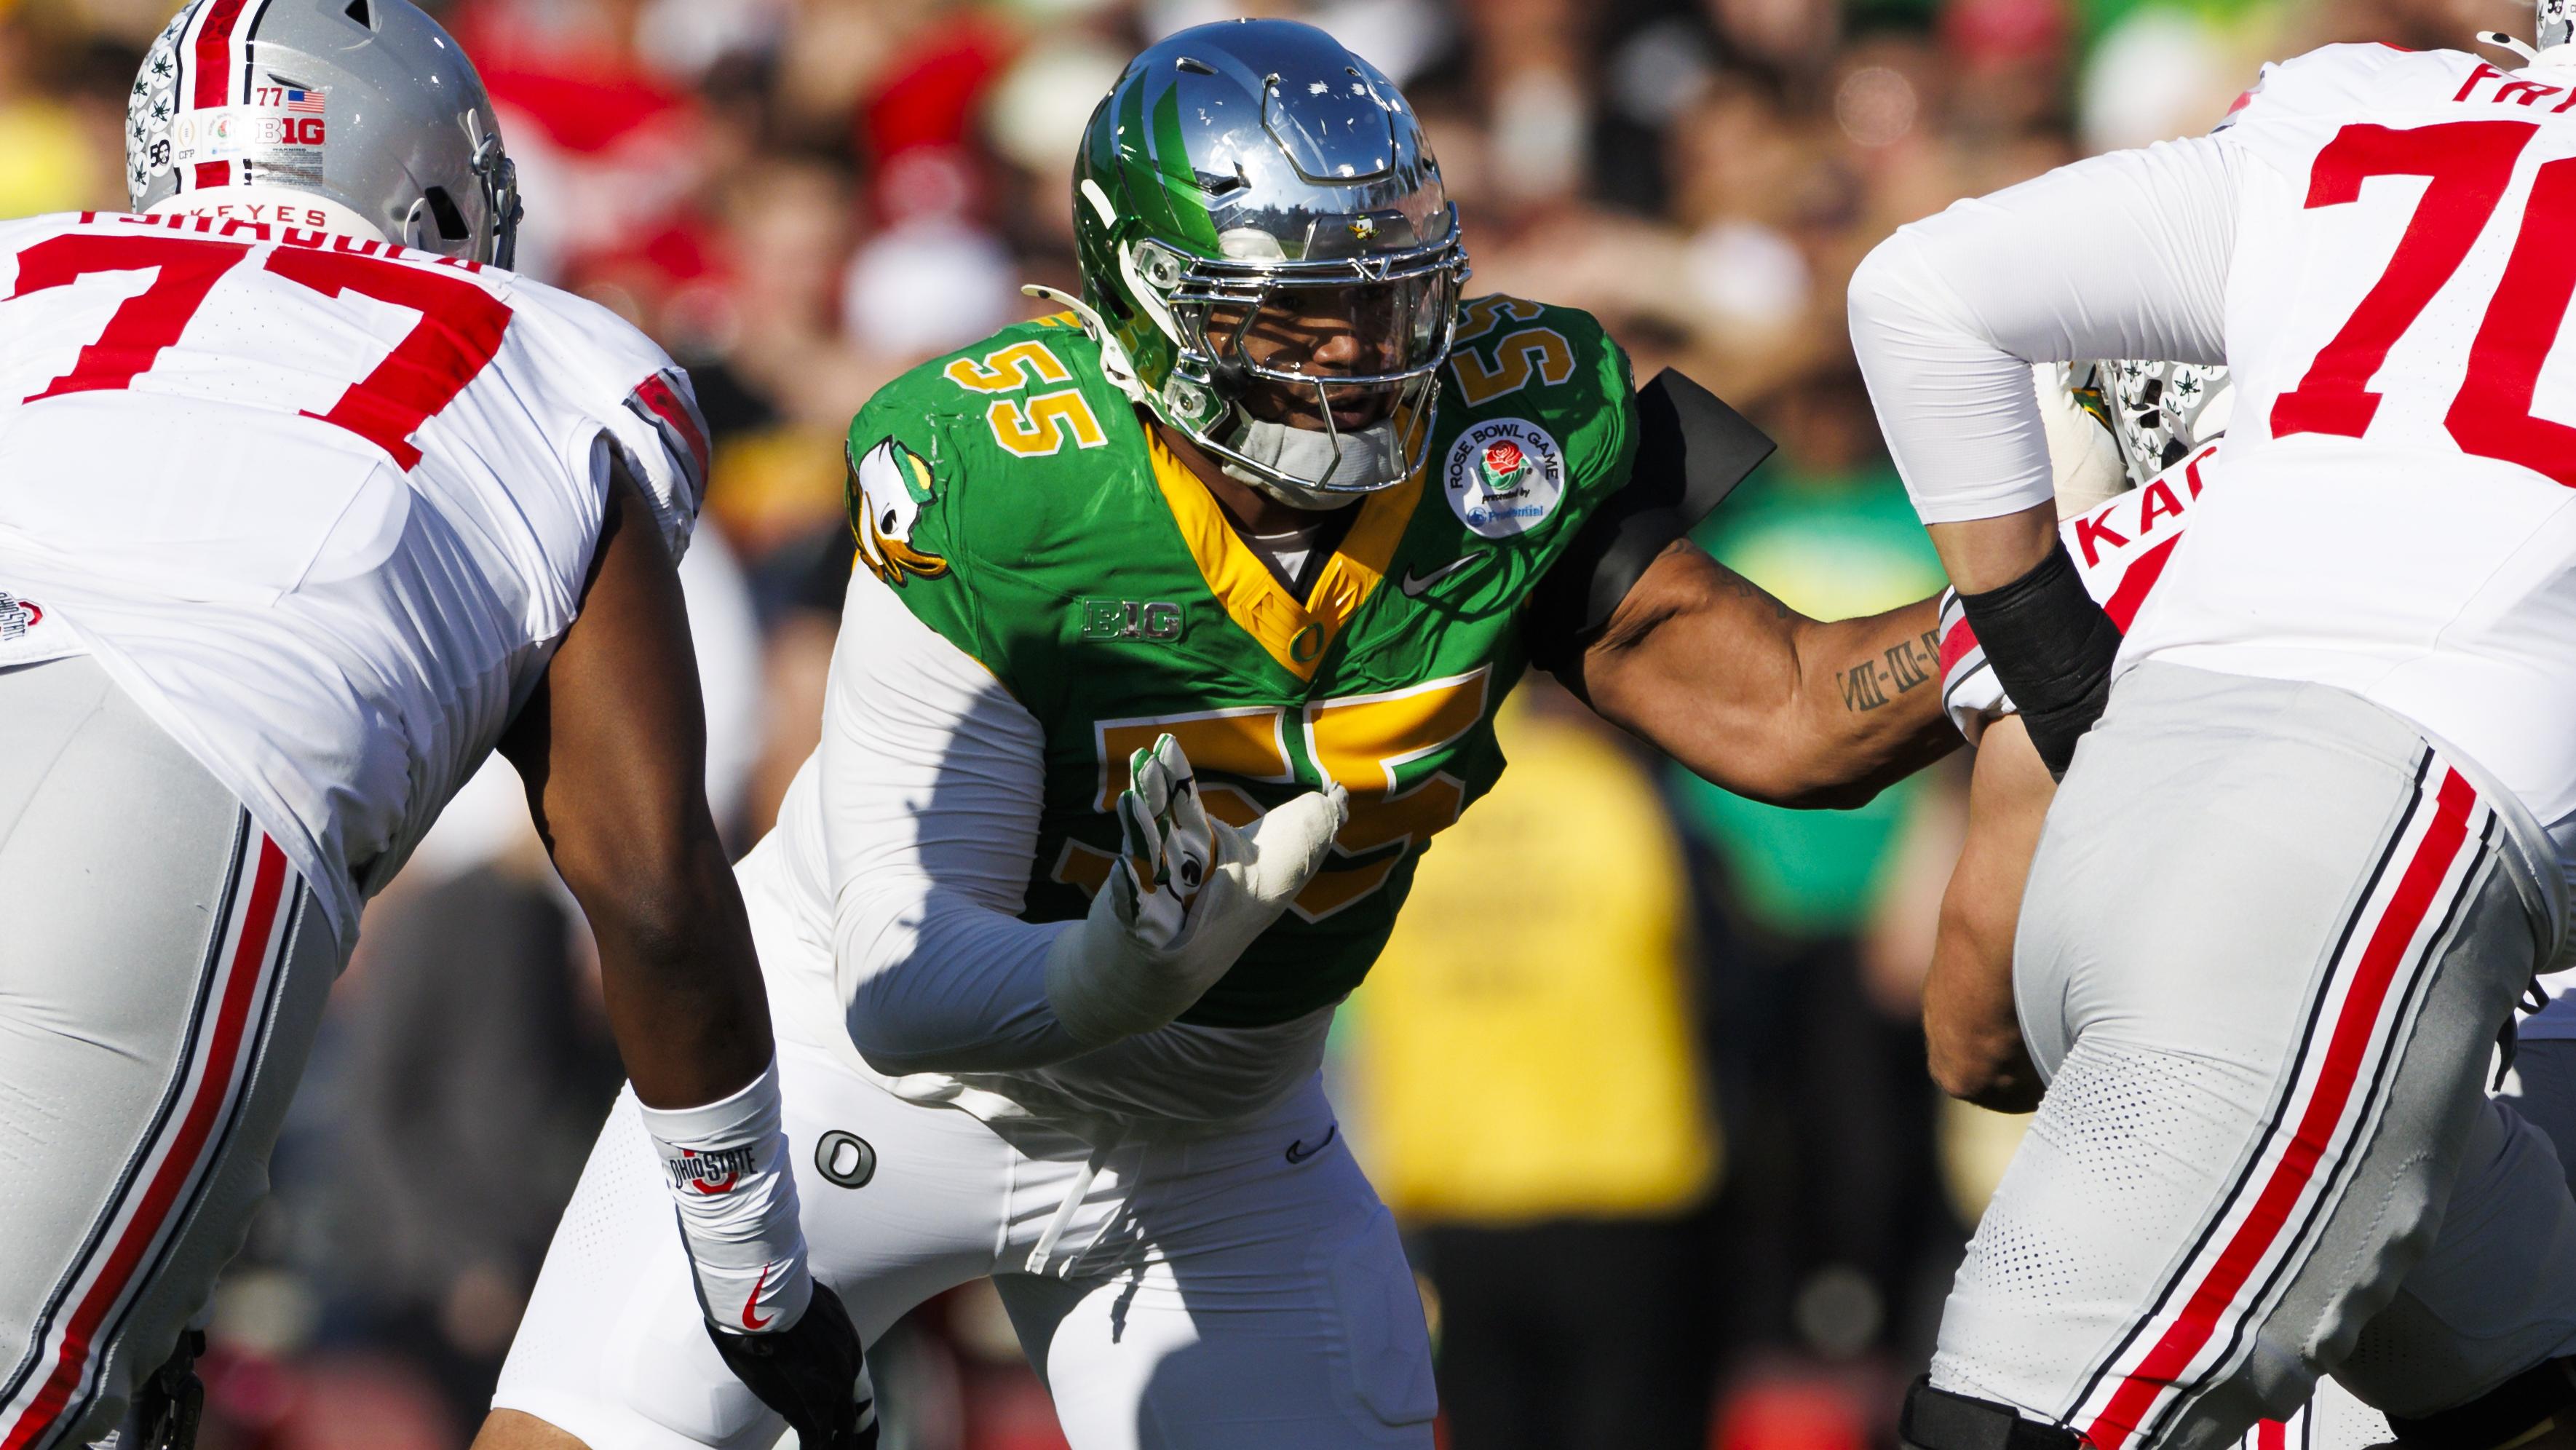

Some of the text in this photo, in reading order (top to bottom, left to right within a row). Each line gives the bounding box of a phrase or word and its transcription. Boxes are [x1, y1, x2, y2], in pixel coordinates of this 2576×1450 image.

[257, 88, 282, 106] 77
[179, 149, 195, 159] CFP
[0, 234, 513, 473] 77
[1450, 293, 1577, 408] 55
[944, 340, 1109, 458] 55
[1450, 424, 1559, 490] ROSE BOWL GAME
[1482, 488, 1530, 504] presented by
[1489, 504, 1543, 522] Prudential
[703, 1147, 758, 1181] STATE
[815, 1130, 876, 1189] O
